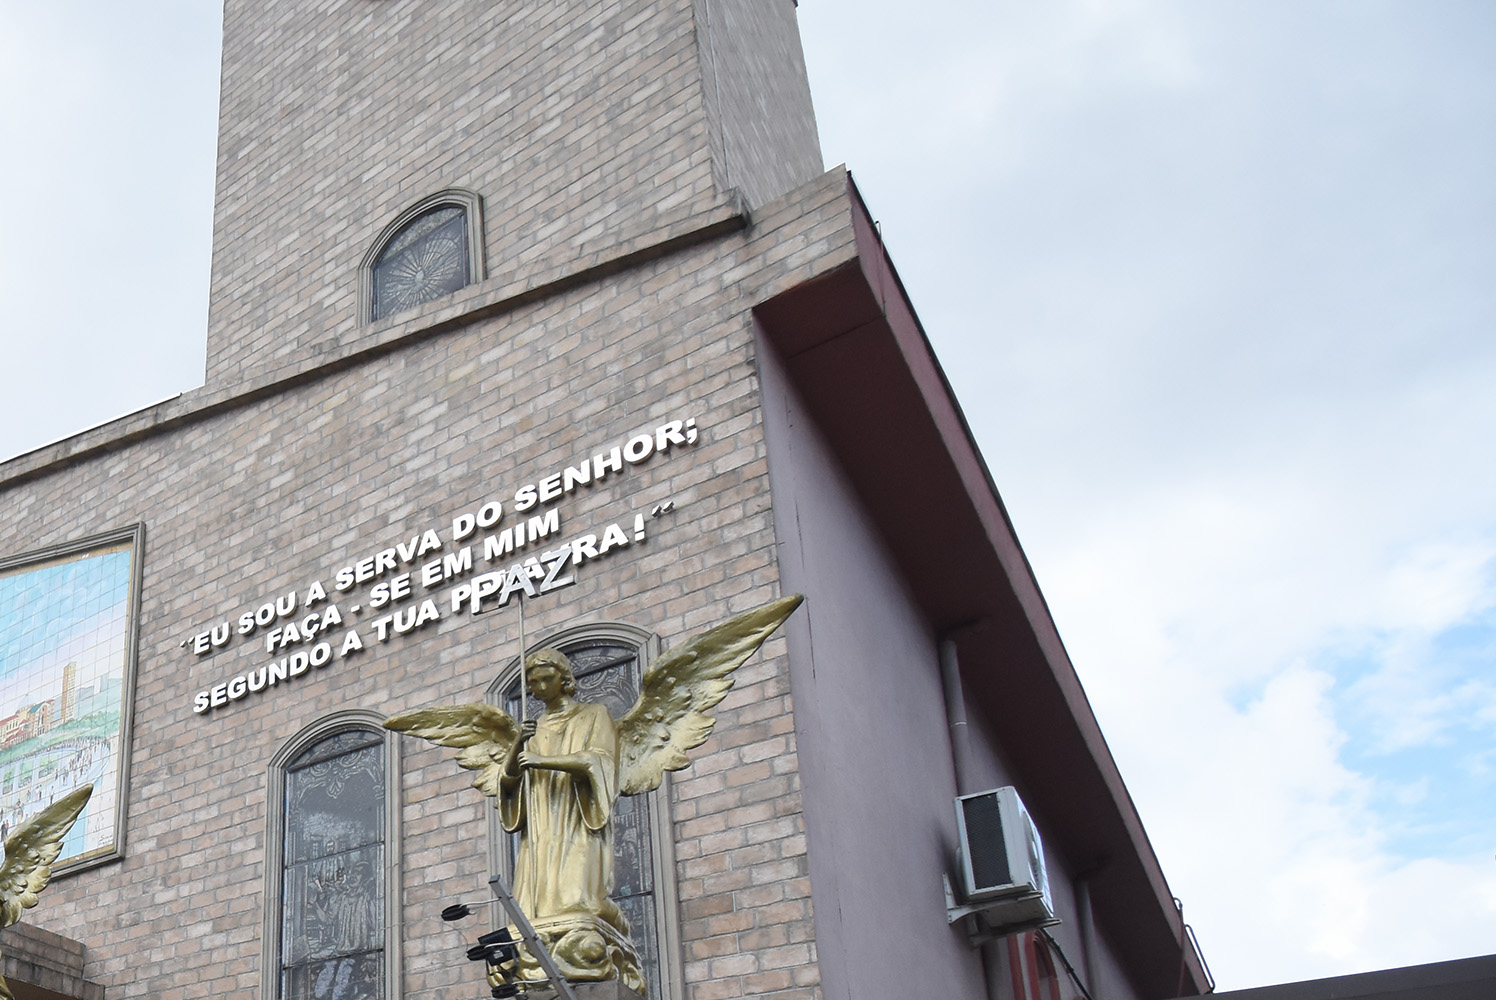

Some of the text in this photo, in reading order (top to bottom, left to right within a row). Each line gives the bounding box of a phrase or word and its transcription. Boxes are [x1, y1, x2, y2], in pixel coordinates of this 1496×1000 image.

[238, 590, 297, 636] SOU
[305, 580, 327, 607] A
[335, 528, 442, 592] SERVA
[453, 501, 503, 542] DO
[514, 417, 698, 513] SENHOR;
[267, 604, 342, 654] FAÇA
[369, 573, 411, 609] SE
[422, 546, 473, 588] EM
[484, 507, 561, 563] MIM
[471, 547, 577, 615] PAZ
[193, 642, 334, 714] SEGUNDO
[340, 630, 364, 658] A
[372, 599, 441, 642] TUA
